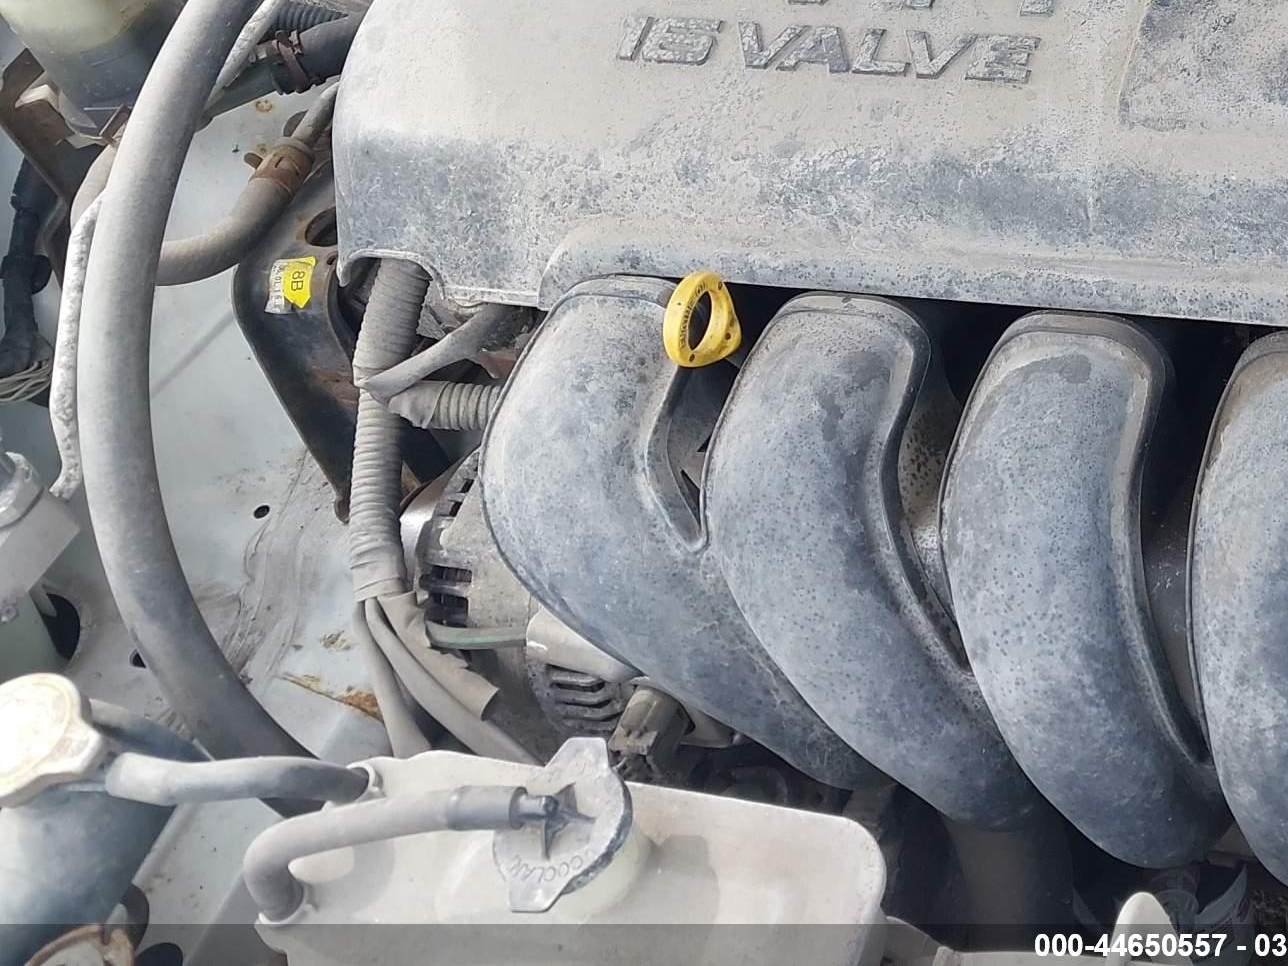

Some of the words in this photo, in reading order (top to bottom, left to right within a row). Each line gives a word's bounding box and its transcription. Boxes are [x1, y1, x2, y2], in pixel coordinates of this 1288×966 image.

[616, 16, 726, 66] 16
[737, 20, 1042, 84] VALVE
[291, 271, 305, 291] 8B
